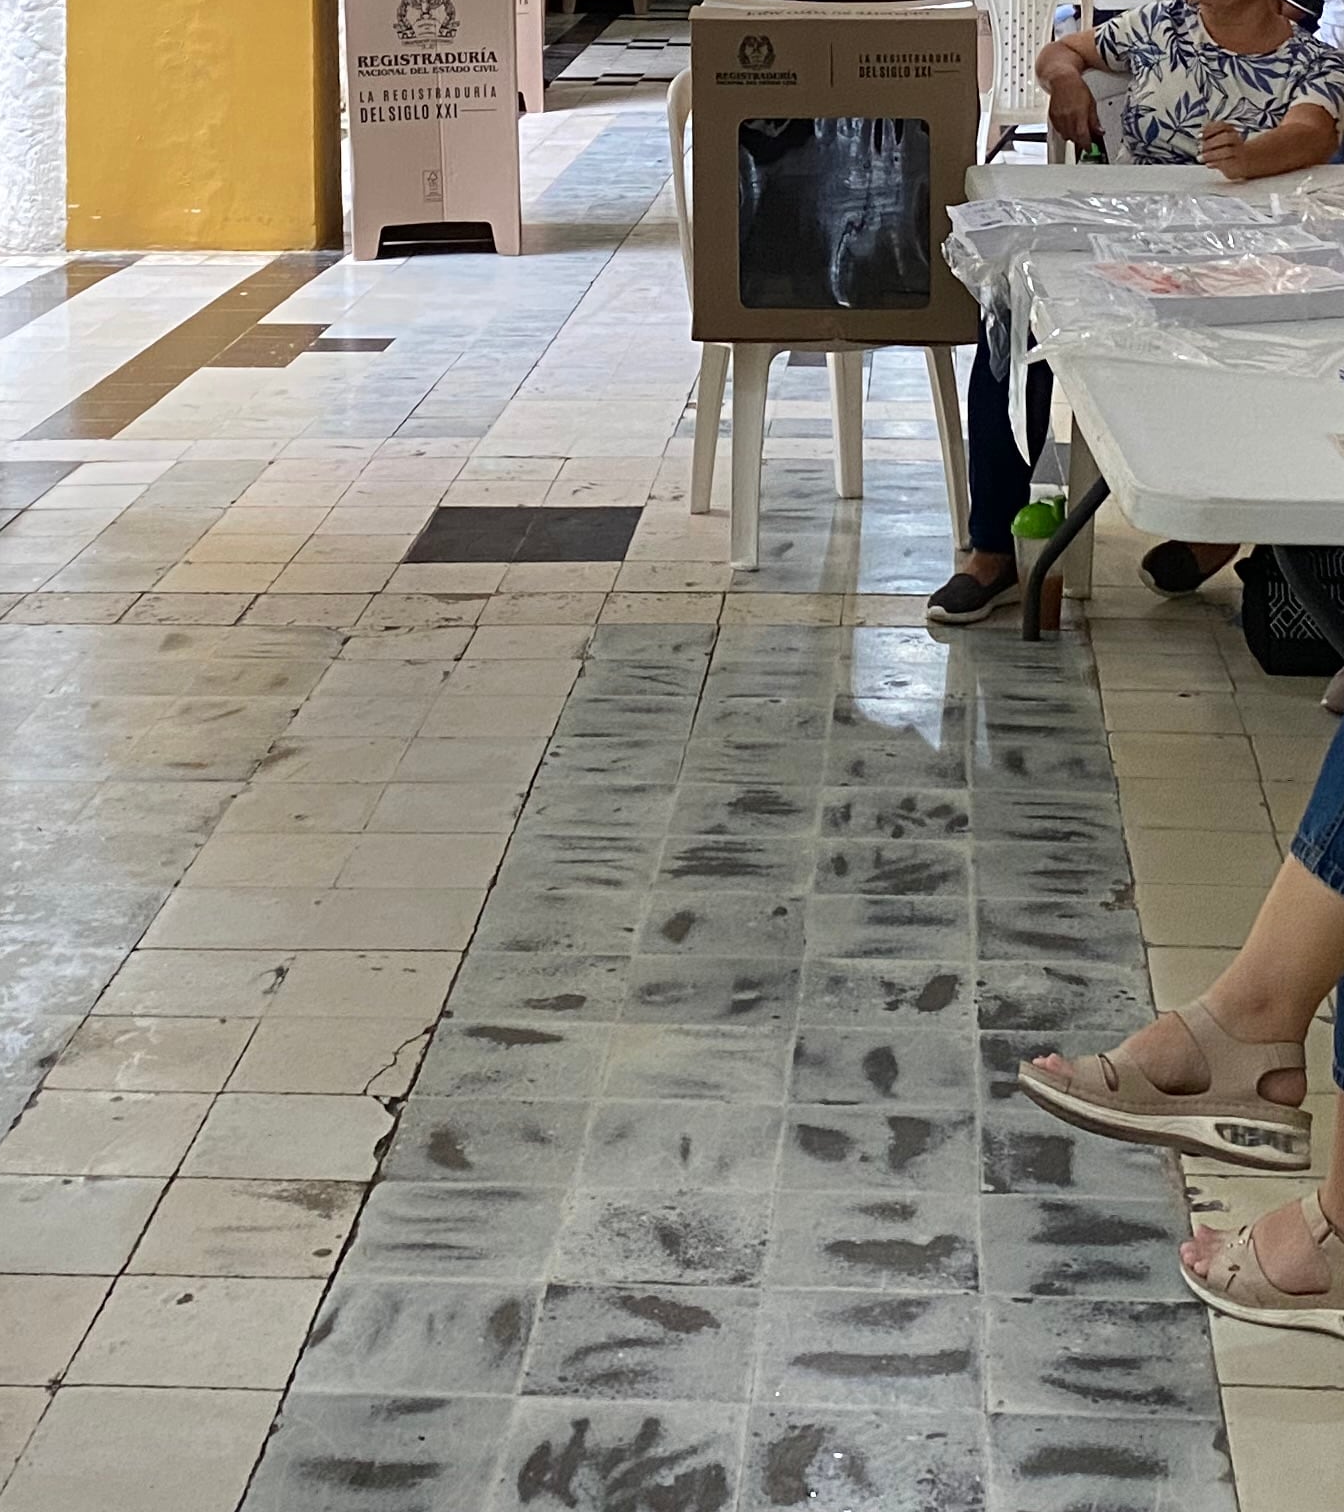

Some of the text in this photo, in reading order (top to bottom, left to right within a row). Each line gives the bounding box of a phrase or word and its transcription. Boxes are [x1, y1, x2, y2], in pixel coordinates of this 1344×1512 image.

[357, 47, 498, 68] REGISTRADURÍA
[358, 64, 499, 78] NACIONAL DEL ESTADO CIVIL
[359, 84, 497, 104] LA REGISTRADURÍA
[436, 103, 459, 120] XXI
